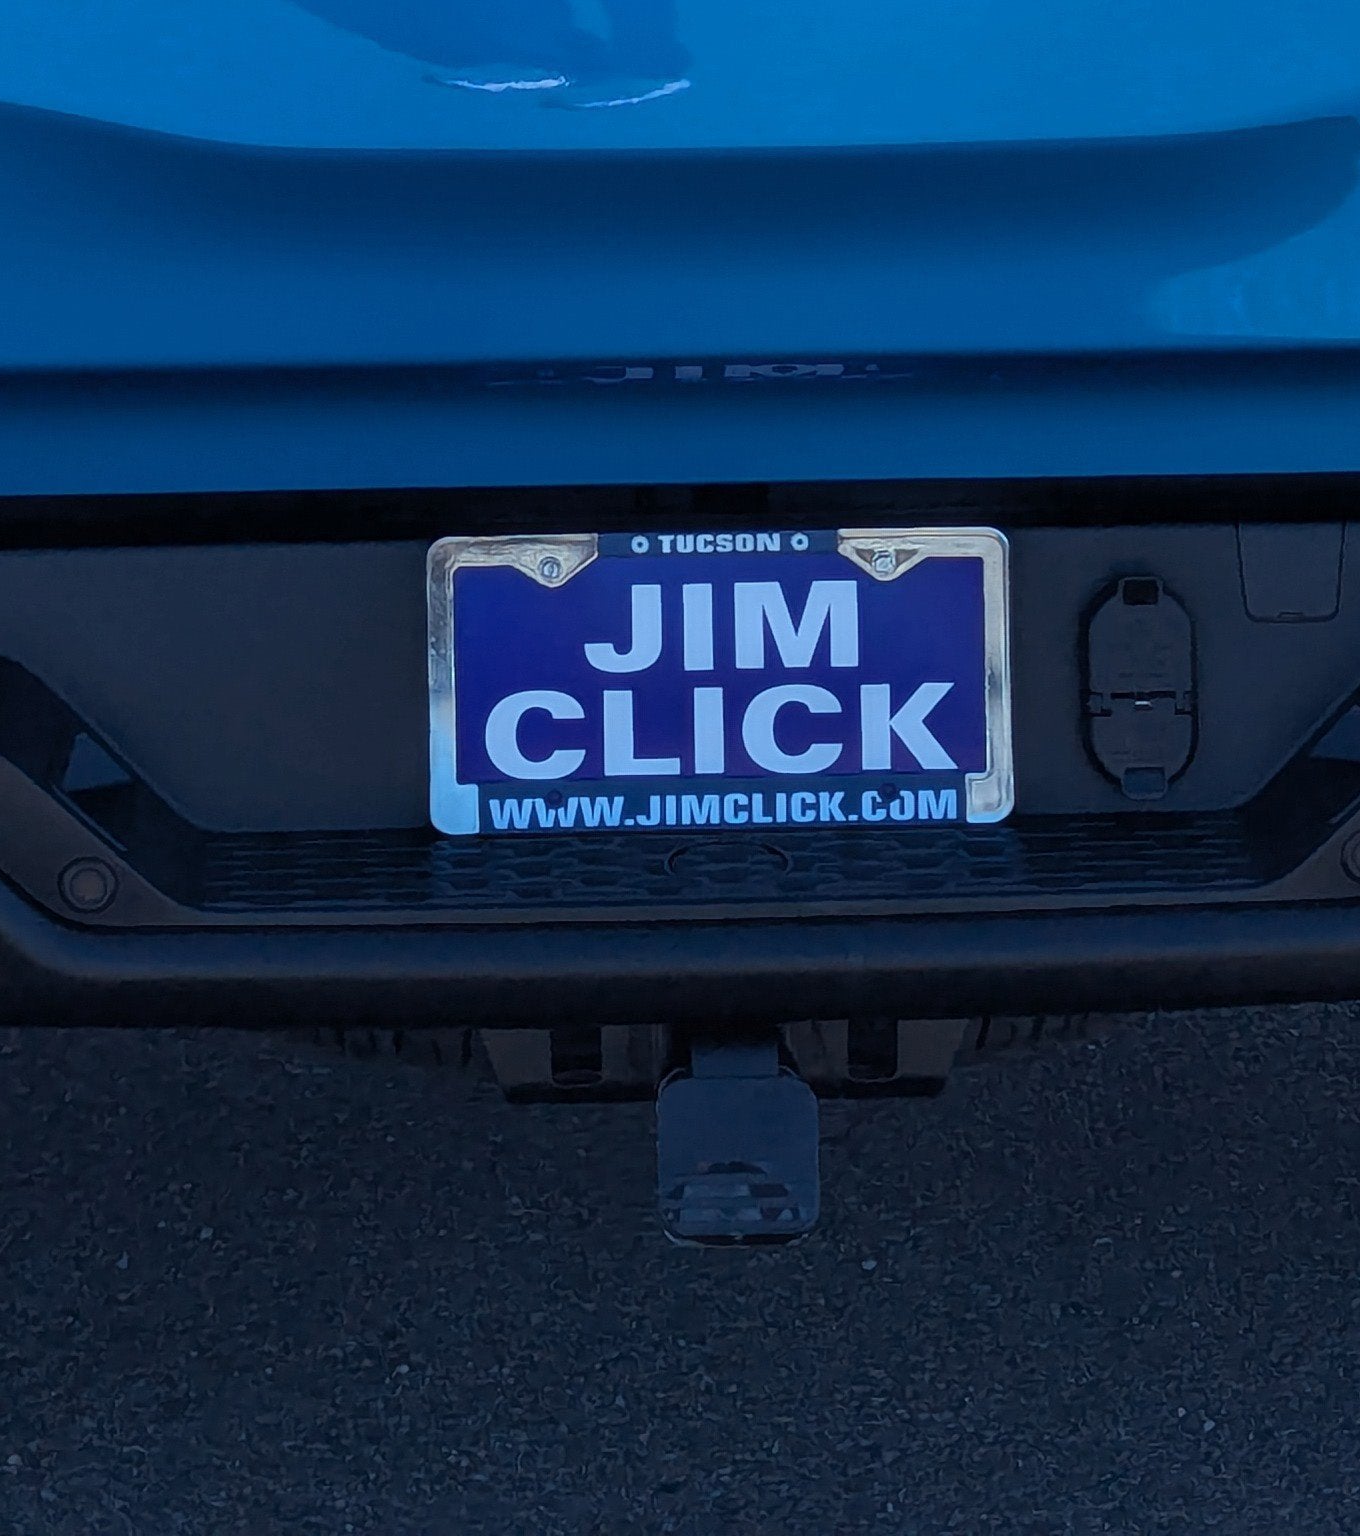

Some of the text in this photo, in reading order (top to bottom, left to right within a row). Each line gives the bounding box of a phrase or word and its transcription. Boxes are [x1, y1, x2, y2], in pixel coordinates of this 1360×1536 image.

[657, 533, 781, 553] TUCSON
[584, 580, 859, 673] JIM
[484, 682, 959, 780] CLICK
[489, 789, 957, 829] WWW.JIMCLICK.COM
